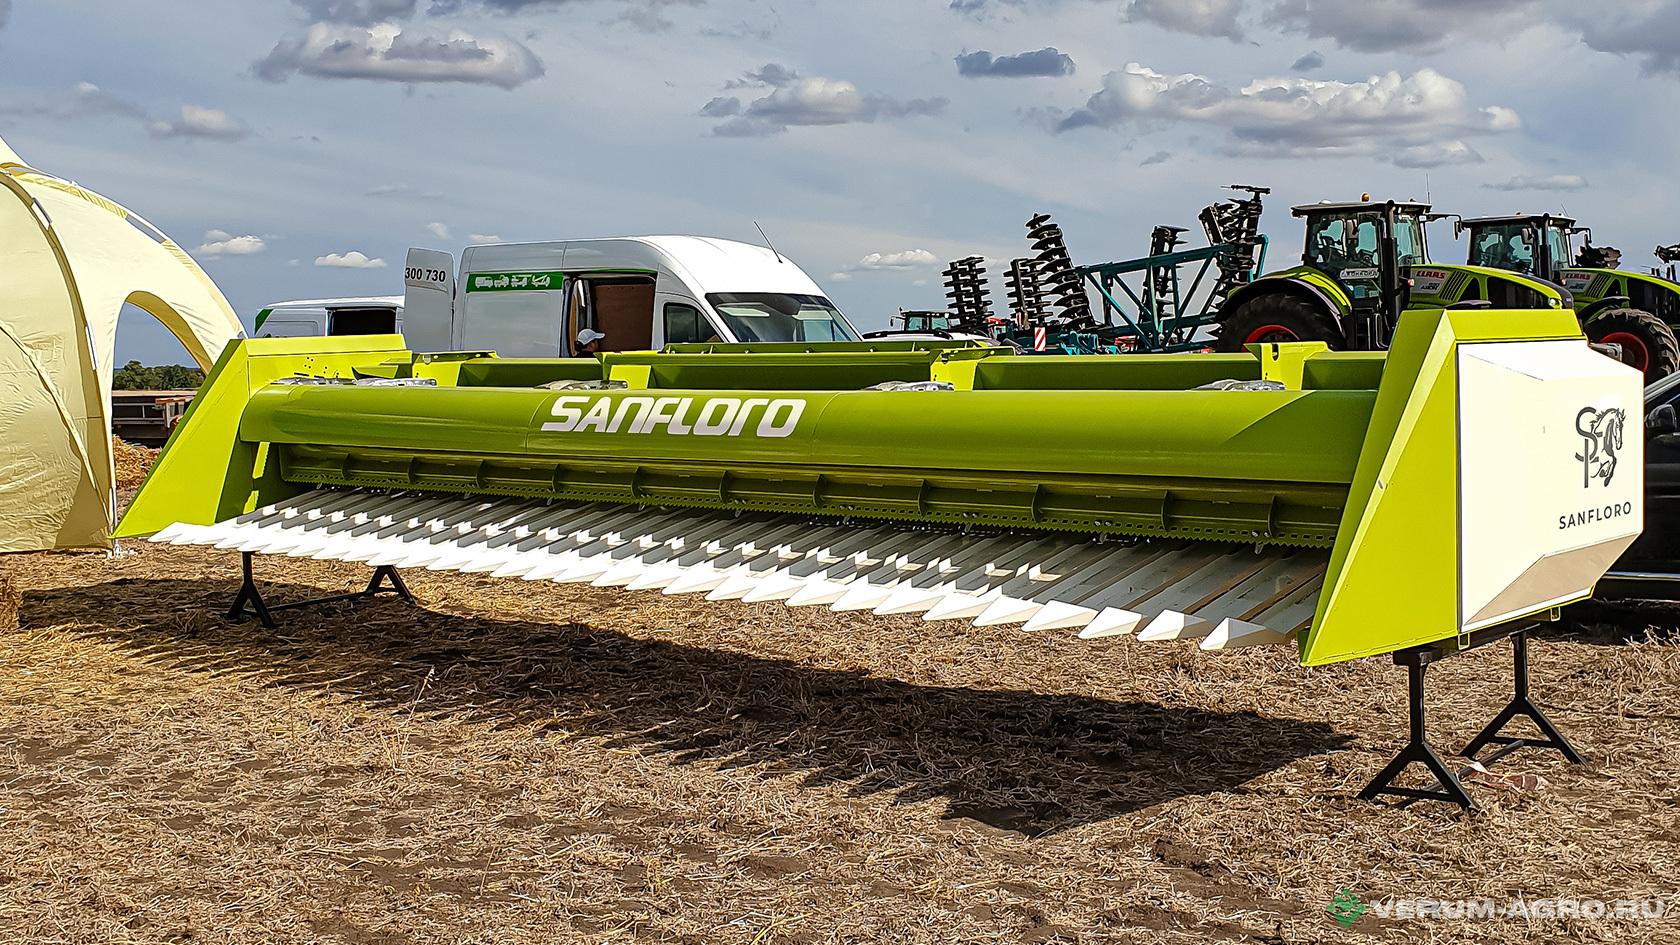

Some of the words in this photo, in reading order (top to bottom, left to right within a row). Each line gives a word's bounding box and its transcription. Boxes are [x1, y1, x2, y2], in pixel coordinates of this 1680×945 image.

[405, 267, 422, 280] 300
[426, 269, 446, 282] 730
[1415, 271, 1446, 279] CLAAS
[541, 396, 806, 437] SANFLORO
[1559, 501, 1632, 530] SANFLORO
